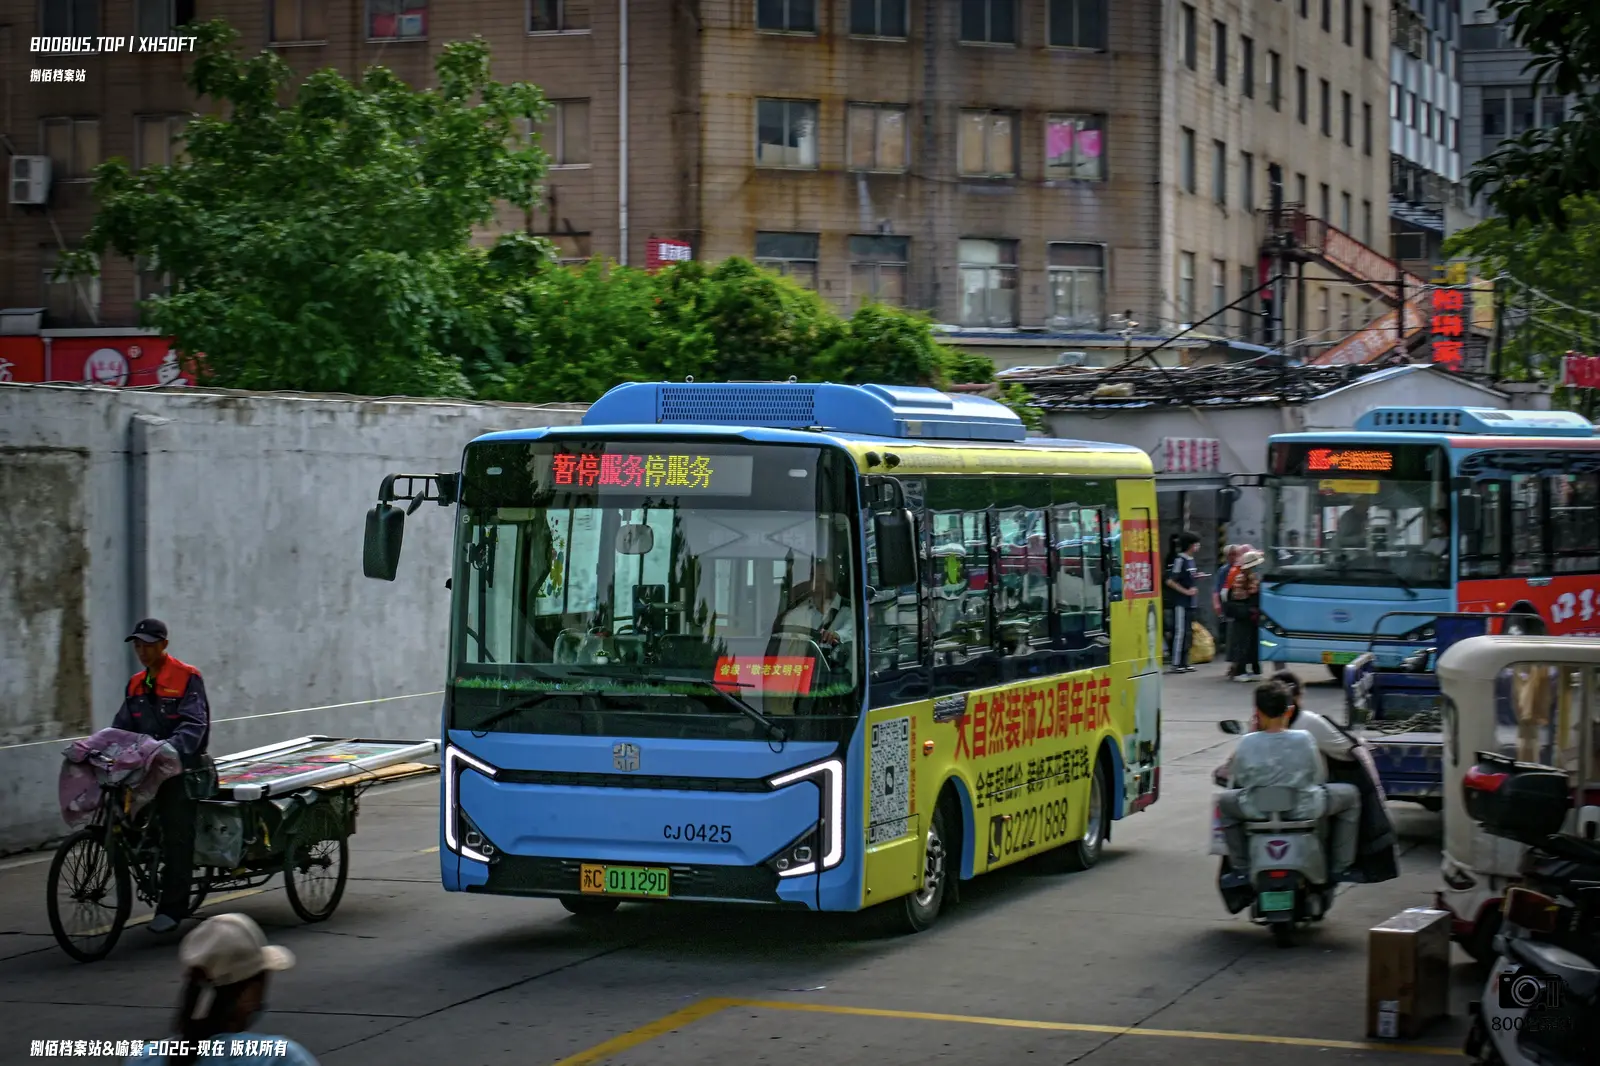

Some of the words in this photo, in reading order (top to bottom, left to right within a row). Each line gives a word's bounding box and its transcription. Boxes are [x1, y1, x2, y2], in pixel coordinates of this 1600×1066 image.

[552, 453, 714, 488] 暂停服务停服务
[720, 663, 740, 676] 省级
[663, 822, 732, 843] CJ0425
[1004, 797, 1068, 855] 82221888
